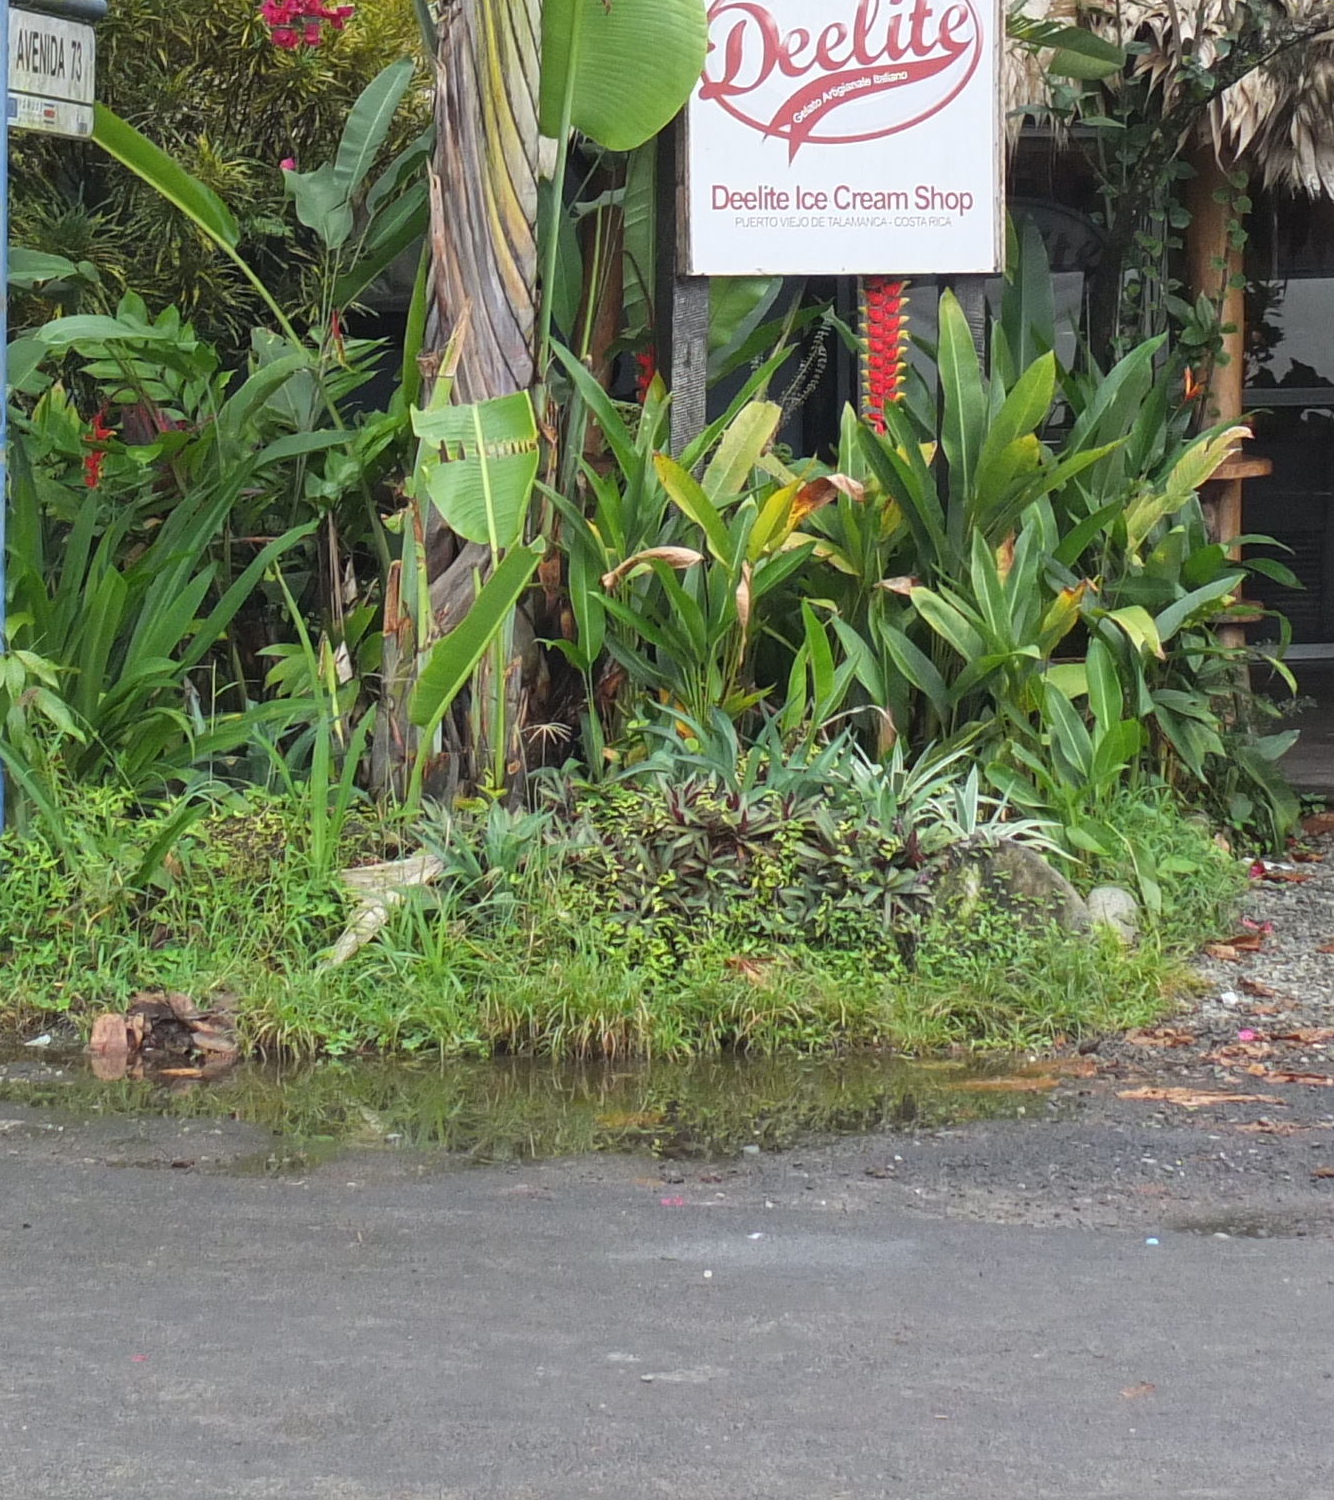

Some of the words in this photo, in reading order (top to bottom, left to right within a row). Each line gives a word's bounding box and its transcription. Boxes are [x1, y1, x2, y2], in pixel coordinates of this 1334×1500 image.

[16, 28, 65, 79] AVENIDA
[71, 40, 82, 82] 73
[793, 98, 822, 123] Gelato
[712, 185, 790, 211] Deelite
[796, 185, 828, 211] Ice
[834, 185, 908, 211] Cream
[914, 185, 974, 217] Shop
[735, 216, 778, 228] PUERTO
[780, 216, 810, 228] VIEJO
[811, 216, 825, 228] DE
[828, 216, 887, 228] TALAMANCA
[894, 216, 927, 228] COSTA
[928, 216, 951, 228] RICA
